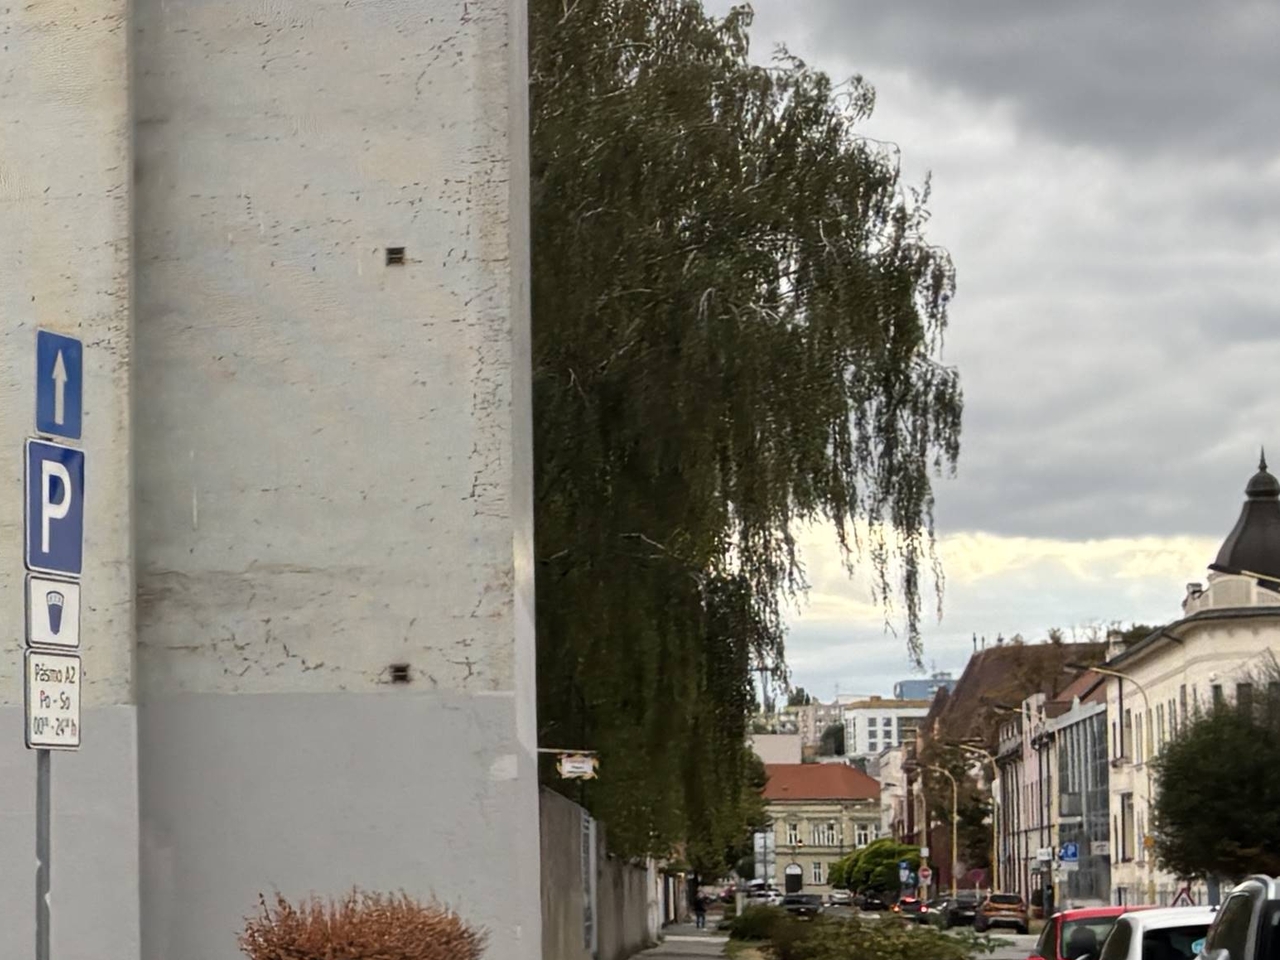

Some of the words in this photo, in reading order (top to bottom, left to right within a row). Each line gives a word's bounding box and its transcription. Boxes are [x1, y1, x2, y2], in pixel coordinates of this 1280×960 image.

[41, 459, 72, 554] P
[35, 663, 62, 683] Pásmo
[65, 665, 76, 684] A2
